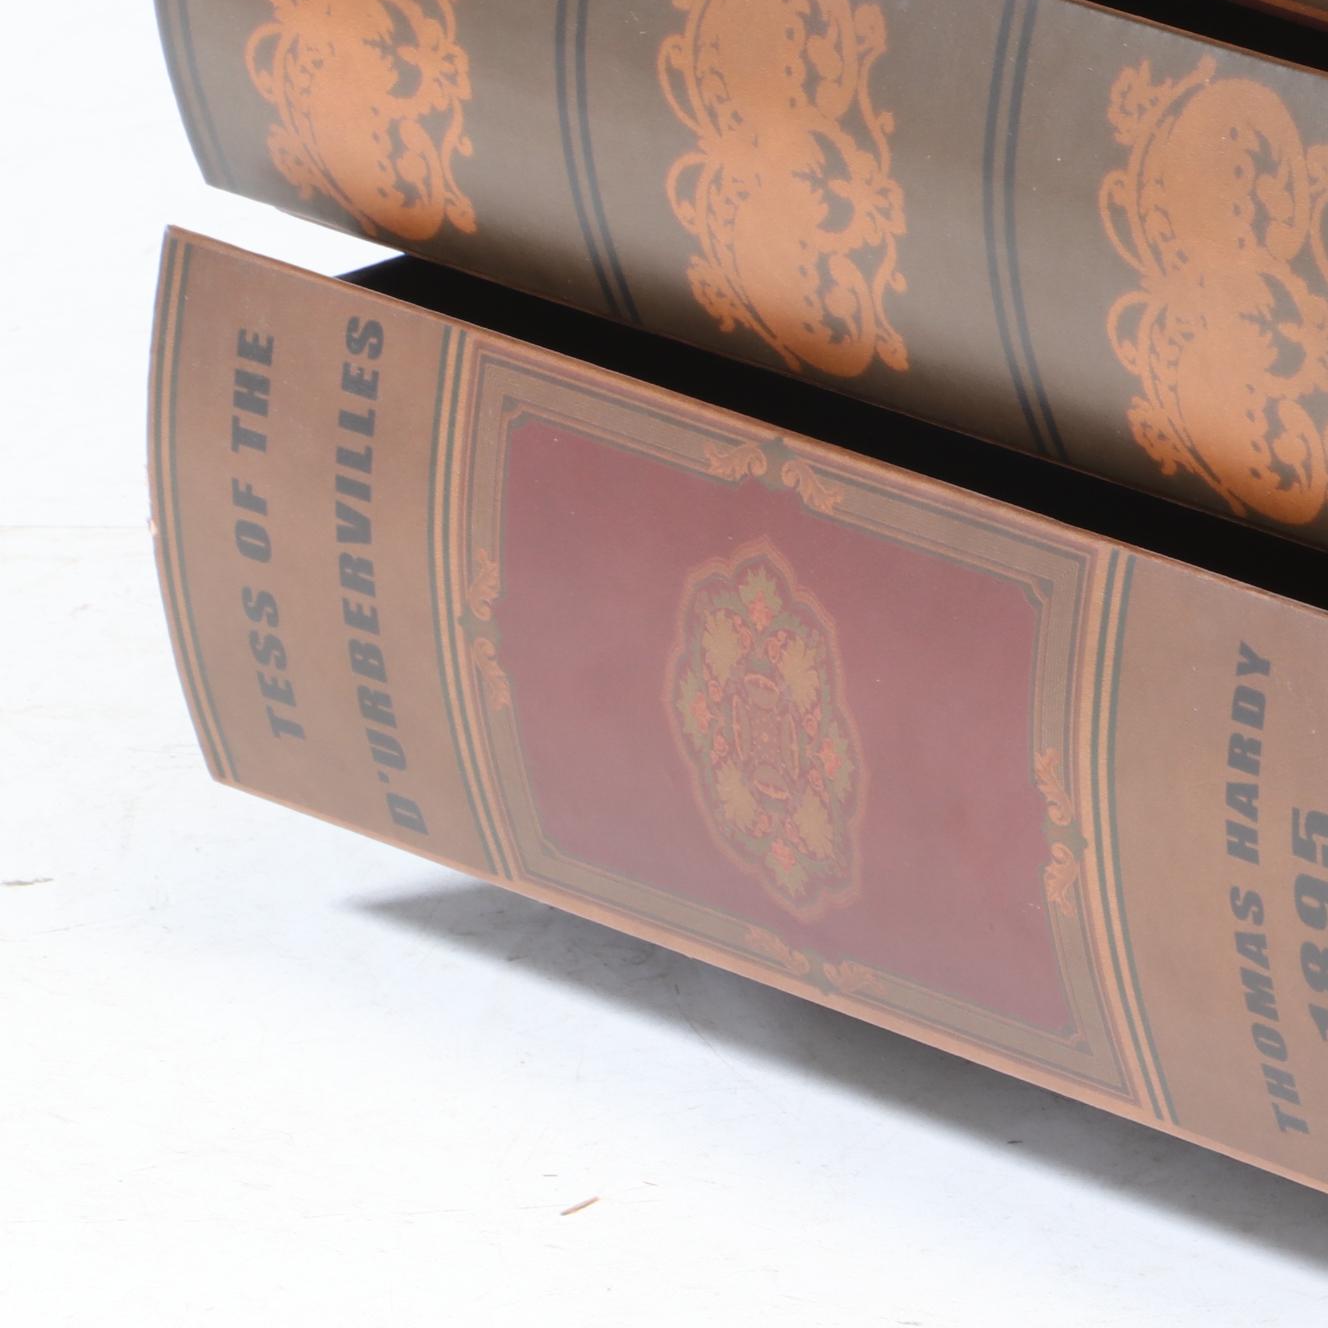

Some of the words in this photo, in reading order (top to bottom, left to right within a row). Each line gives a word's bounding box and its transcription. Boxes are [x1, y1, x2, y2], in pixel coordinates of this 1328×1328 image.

[230, 328, 274, 454] THE
[231, 477, 274, 564] OF
[335, 316, 429, 835] D'URBERVILLES
[243, 586, 306, 740] TESS
[1225, 640, 1272, 866] HARDY
[1229, 885, 1310, 1134] THOMAS
